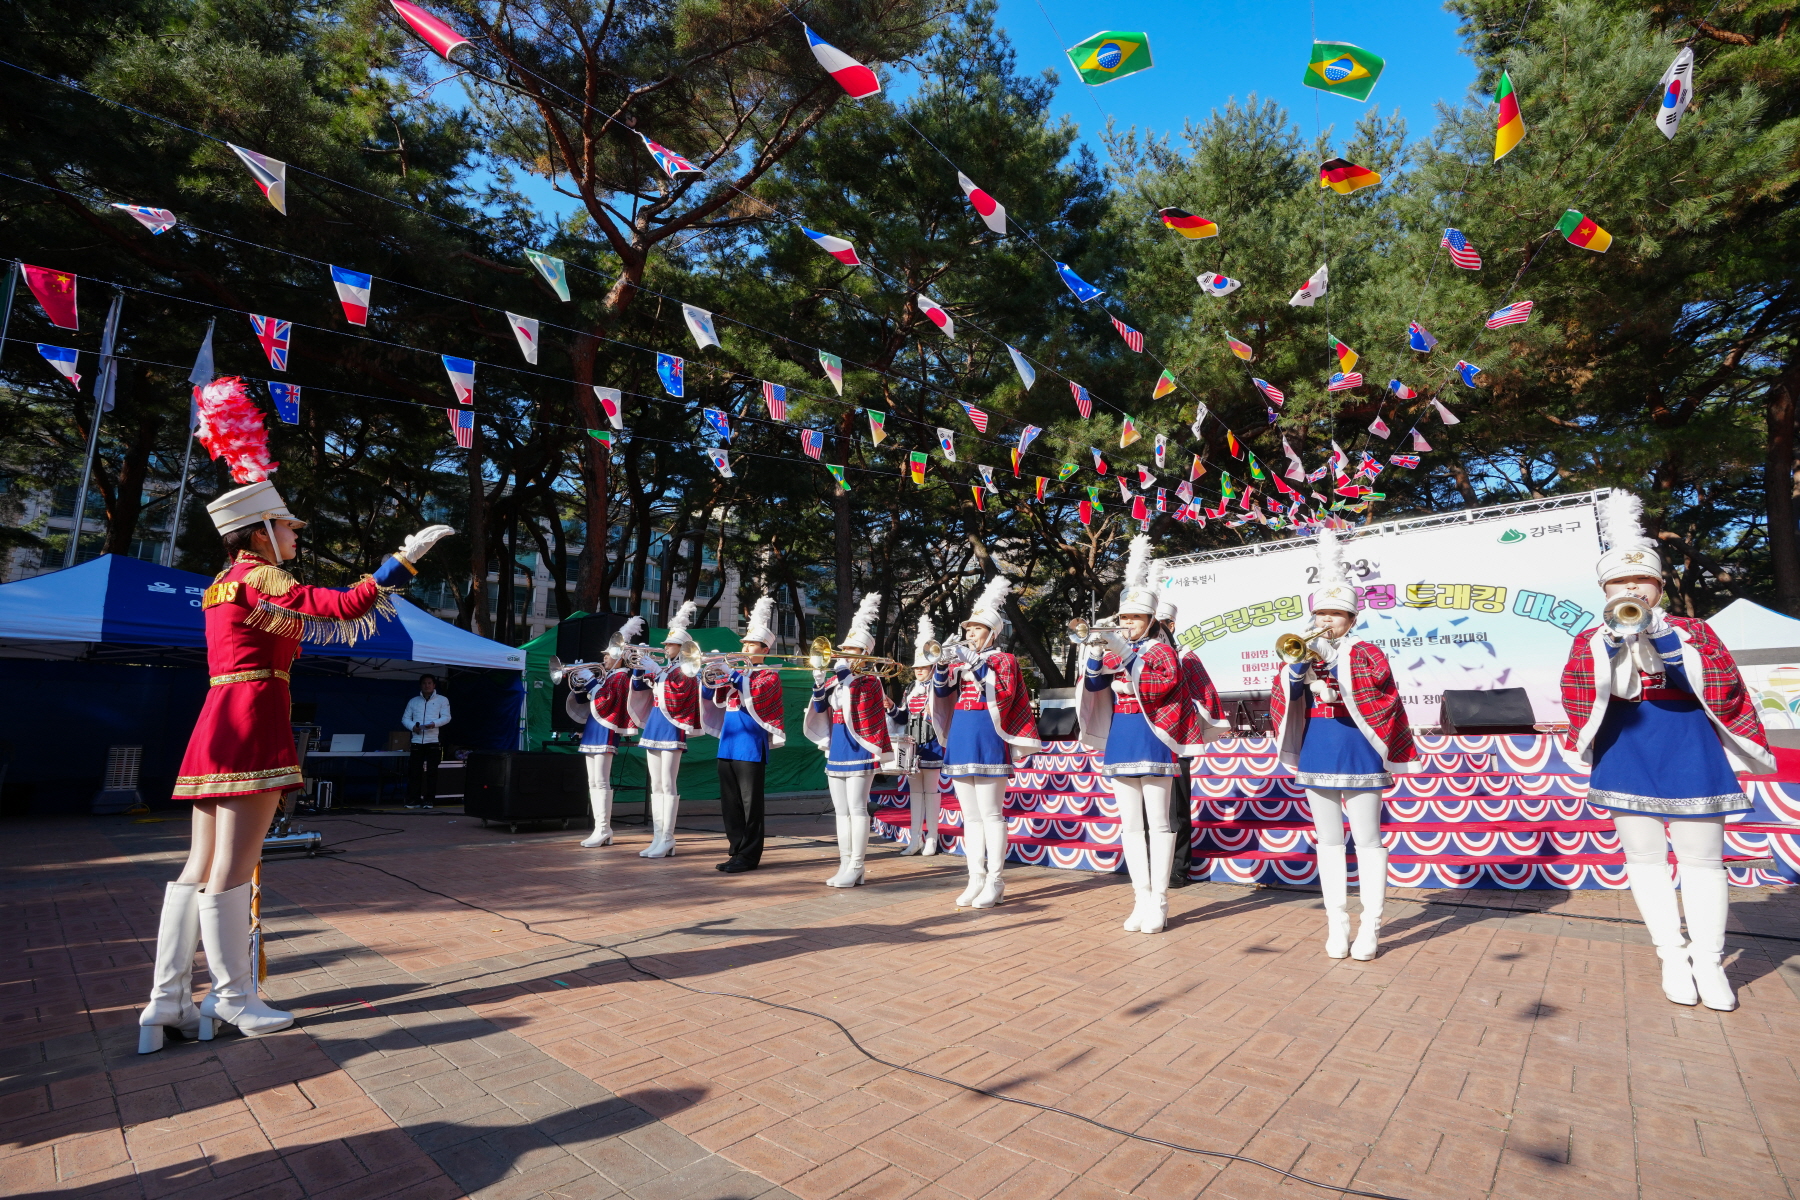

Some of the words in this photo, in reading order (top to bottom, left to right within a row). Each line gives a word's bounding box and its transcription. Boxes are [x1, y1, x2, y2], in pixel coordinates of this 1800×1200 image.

[1530, 521, 1581, 538] 강북구
[1305, 558, 1371, 585] 223
[1174, 573, 1216, 588] 서울특별시
[1403, 583, 1508, 614] 트래킹
[1512, 589, 1595, 637] 대회
[1390, 636, 1423, 648] 어울림
[1241, 650, 1269, 660] 대회명
[1242, 662, 1279, 672] 대회일시
[1242, 676, 1261, 686] 장소
